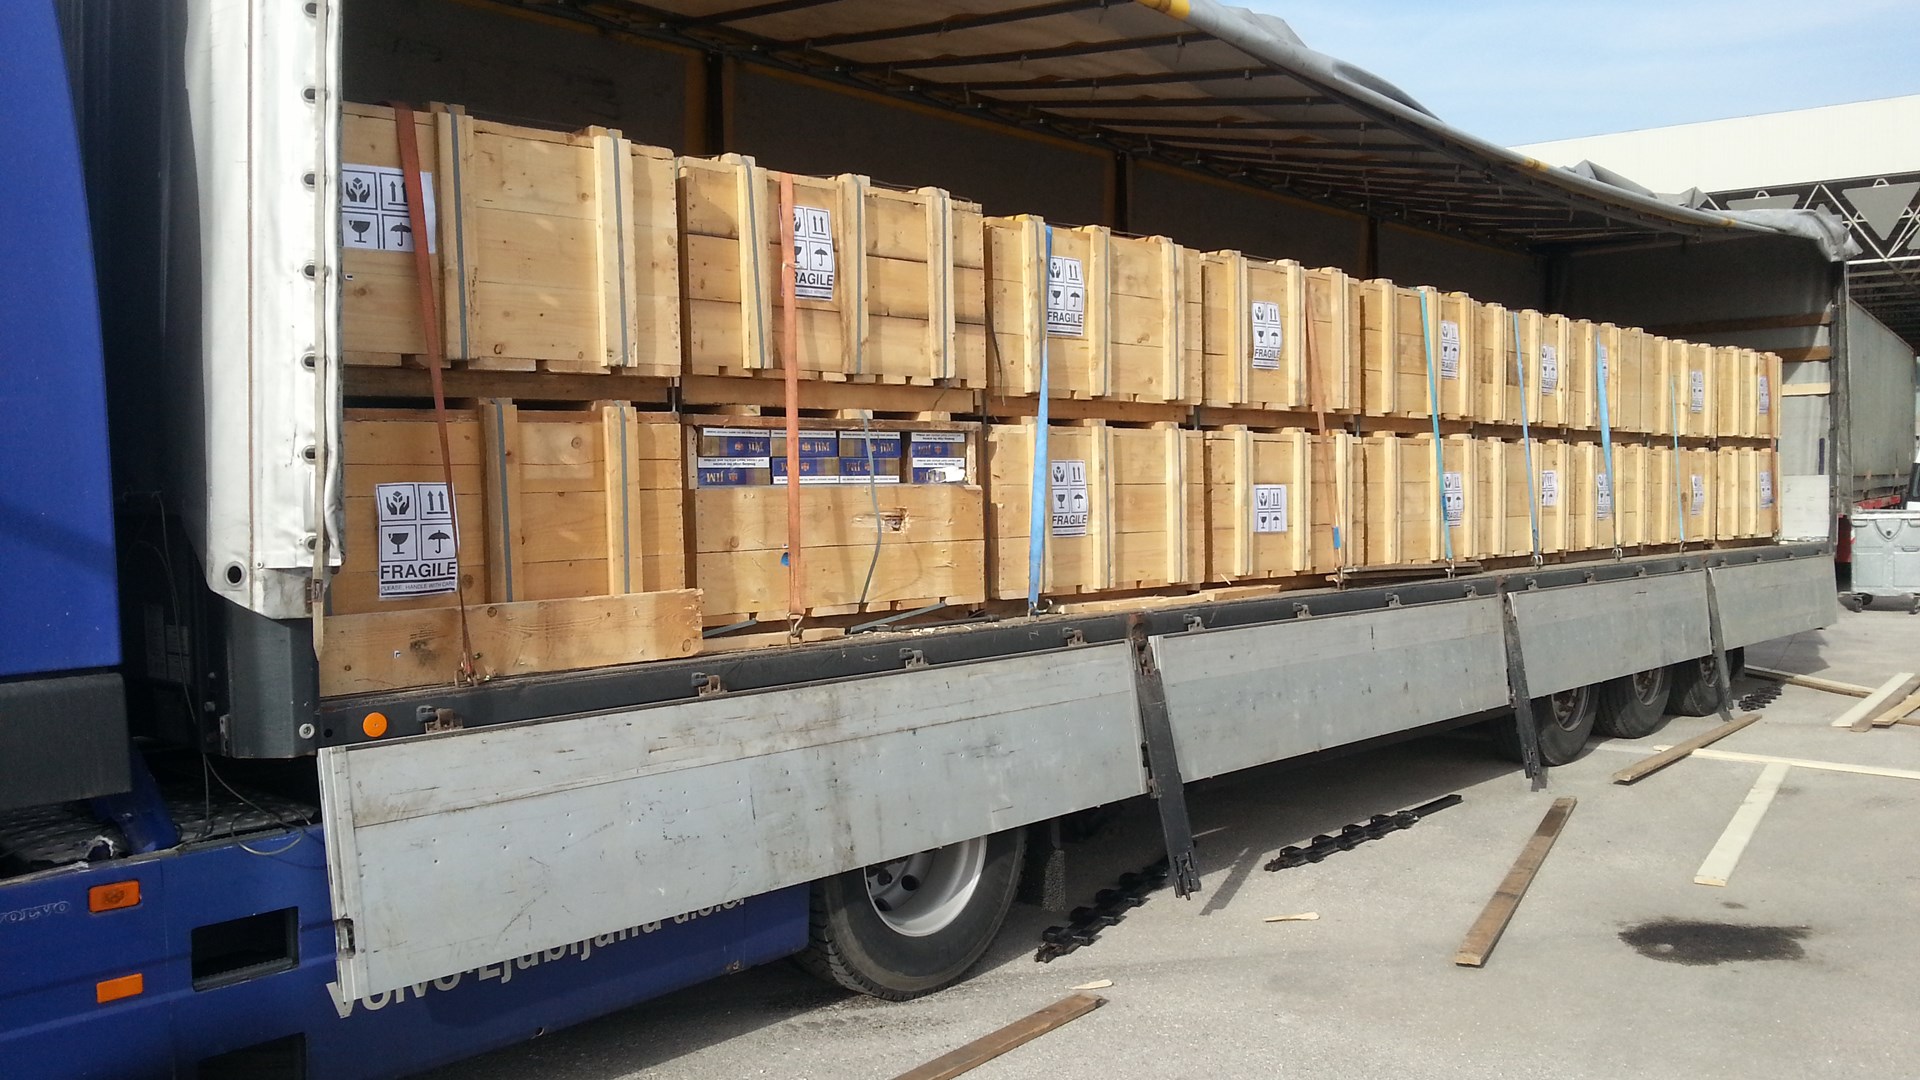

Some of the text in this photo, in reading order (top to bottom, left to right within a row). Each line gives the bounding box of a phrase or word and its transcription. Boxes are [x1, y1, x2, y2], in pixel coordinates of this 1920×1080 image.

[795, 271, 834, 286] RAGILE
[1047, 311, 1083, 324] FRAGILE
[1254, 348, 1280, 359] FRAGILE
[706, 470, 724, 483] JIM
[1052, 514, 1087, 526] FRAGILE
[381, 562, 457, 580] FRAGILE
